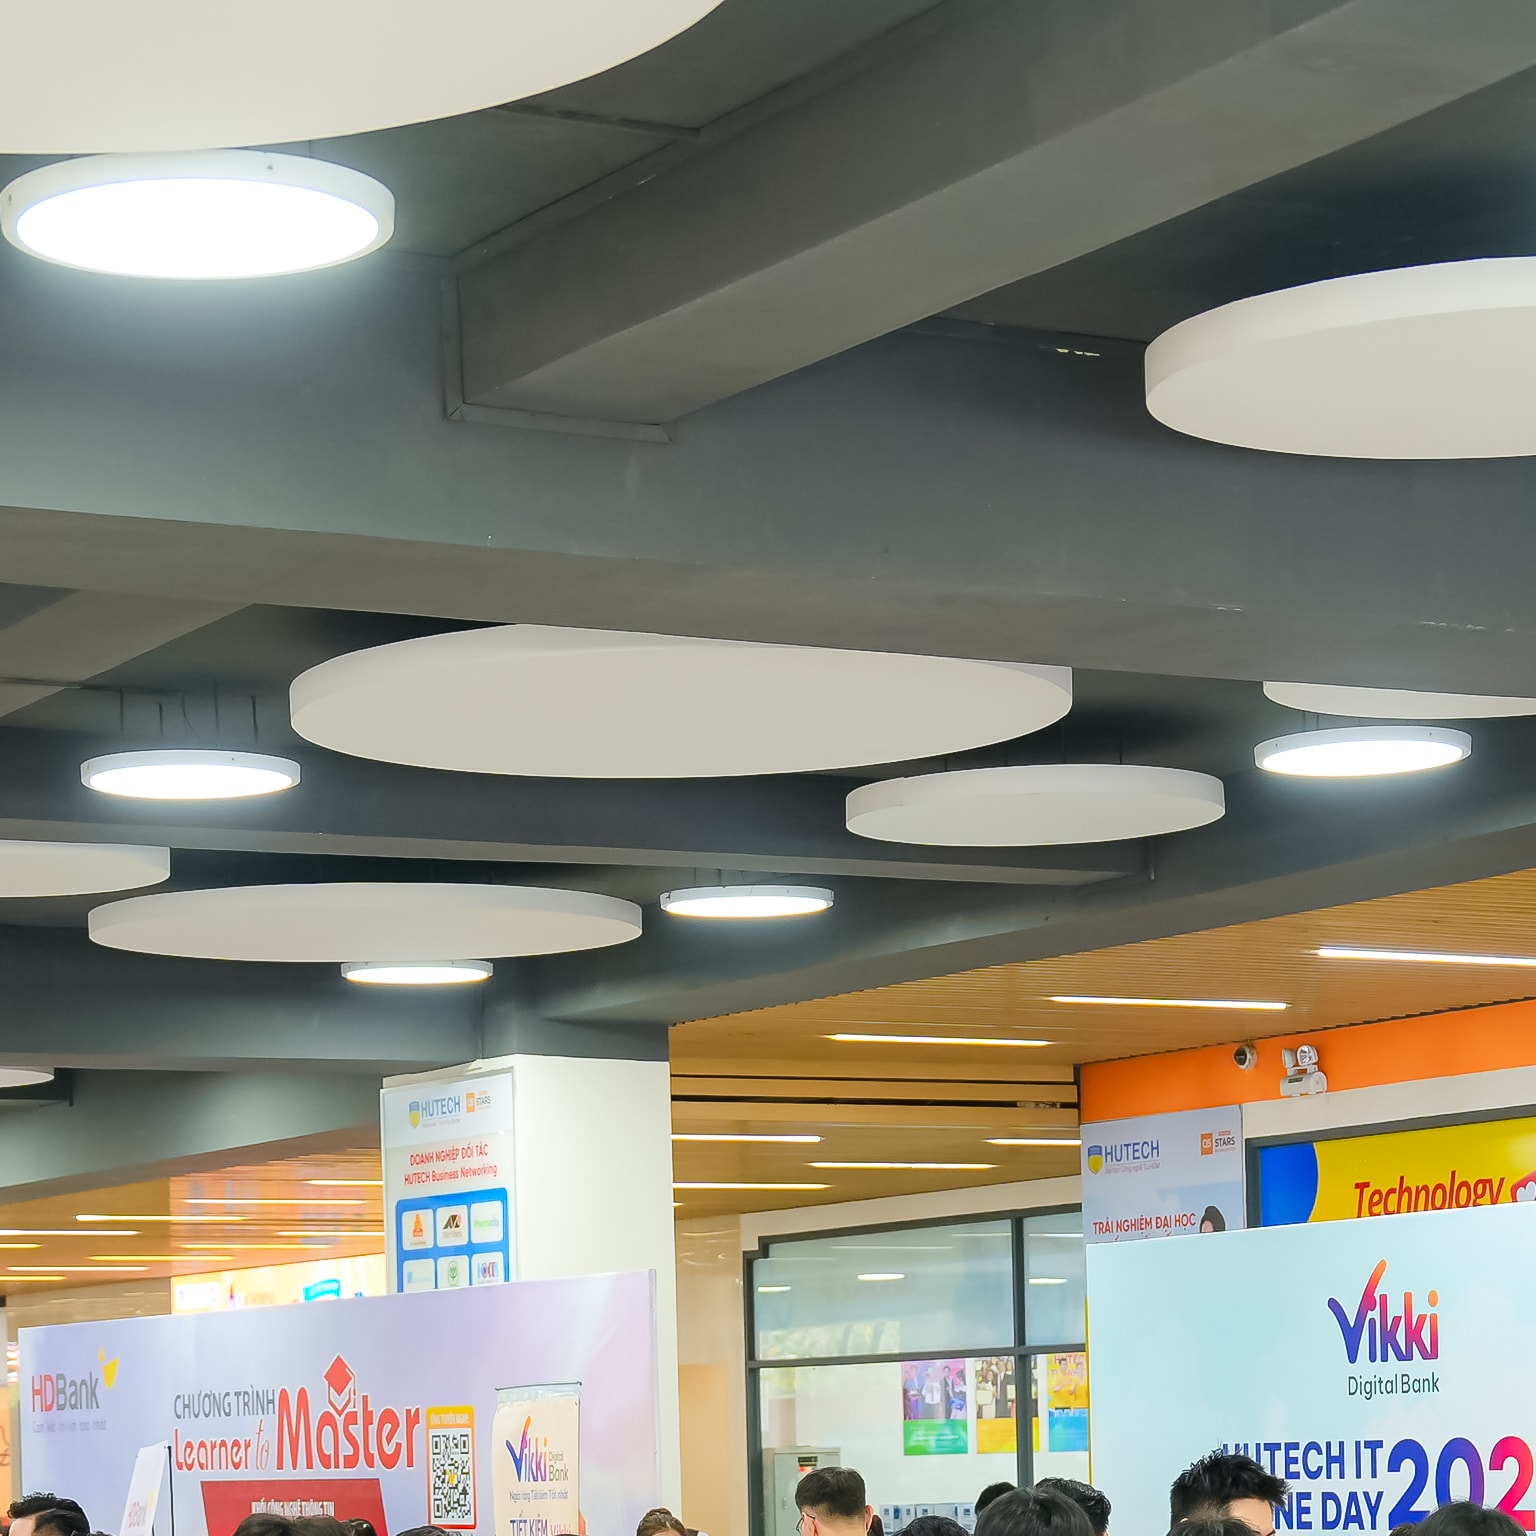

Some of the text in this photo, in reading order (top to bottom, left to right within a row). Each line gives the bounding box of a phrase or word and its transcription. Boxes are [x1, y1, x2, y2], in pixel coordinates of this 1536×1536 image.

[421, 1096, 461, 1118] HUTECH
[1105, 1140, 1160, 1163] HUTECH
[1215, 1137, 1236, 1148] STARS
[404, 1164, 498, 1185] HUTECH Business Networking
[1354, 1170, 1506, 1218] Technology
[1328, 1259, 1439, 1364] Vikki
[31, 1371, 101, 1413] HDBank
[1348, 1371, 1440, 1401] Digital Bank
[174, 1385, 420, 1471] CHƯƠNG TRÌNH Master
[174, 1418, 270, 1472] Learner to
[505, 1416, 547, 1482] Vikki
[1355, 1439, 1384, 1479] IT
[549, 1464, 569, 1481] Bank
[1321, 1490, 1384, 1531] DAY
